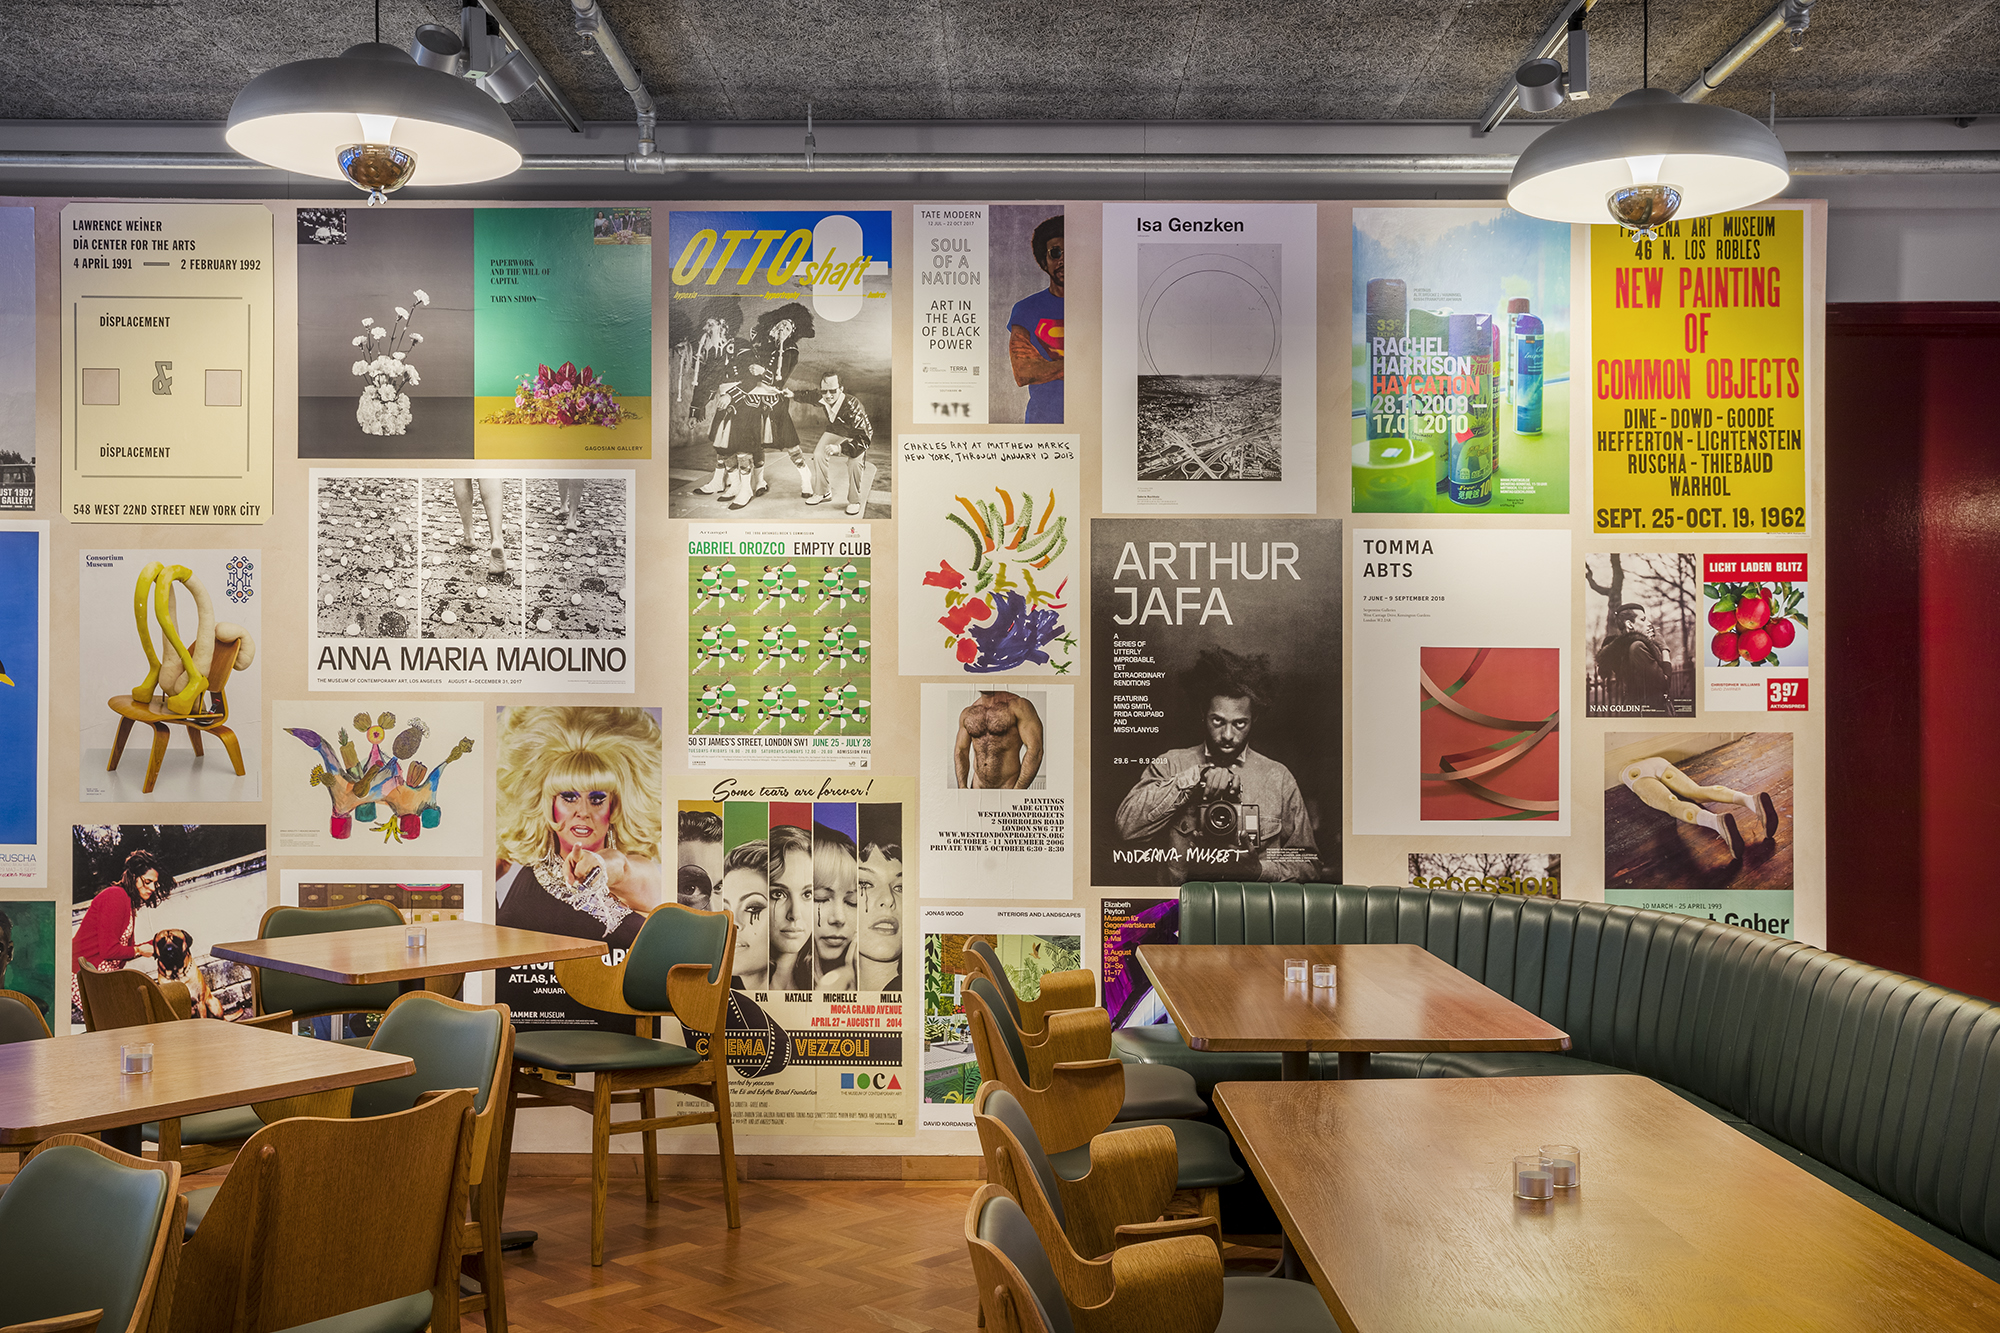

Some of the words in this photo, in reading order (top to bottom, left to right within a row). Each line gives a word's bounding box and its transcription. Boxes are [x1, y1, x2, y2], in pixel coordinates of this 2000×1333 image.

[73, 219, 122, 232] LAWRENCE
[1137, 217, 1162, 232] Isa
[1168, 217, 1244, 232] Genzken
[1691, 216, 1712, 237] ART
[1724, 216, 1775, 237] MUSEUM
[91, 239, 127, 251] CENTER
[130, 239, 148, 251] FOR
[152, 239, 169, 251] THE
[172, 239, 196, 251] ARTS
[931, 238, 971, 252] SOUL
[1685, 240, 1706, 260] LOS
[1716, 240, 1760, 260] ROBLES
[73, 258, 80, 269] 4
[112, 258, 132, 270] 1991
[180, 259, 187, 270] 2
[190, 259, 237, 271] FEBRUARY
[240, 259, 261, 271] 1992
[671, 228, 813, 286] OTTO
[799, 247, 873, 292] shaft
[932, 255, 952, 269] OF
[958, 255, 969, 269] A
[921, 271, 981, 285] NATION
[1615, 267, 1664, 308] NEW
[1679, 267, 1781, 308] PAINTING
[764, 291, 801, 300] hypertrophy
[931, 300, 953, 311] ART
[958, 300, 971, 311] IN
[926, 313, 948, 324] THE
[952, 313, 977, 324] AGE
[922, 326, 937, 337] OF
[942, 326, 981, 337] BLACK
[1685, 312, 1711, 353] OF
[929, 339, 973, 350] POWER
[1372, 337, 1448, 356] RACHEL
[1373, 356, 1471, 375] HARRISON
[1373, 376, 1480, 395] HAYCATION
[1597, 359, 1691, 400] COMMON
[1706, 358, 1799, 399] OBJECTS
[931, 402, 970, 418] TATE
[1372, 395, 1468, 414] 28.11.2009
[1372, 415, 1468, 433] 17.01.2010
[1624, 408, 1656, 429] DINE
[1671, 408, 1713, 428] DOWD
[1727, 407, 1775, 428] GOODE
[903, 442, 947, 451] CHARLES
[950, 441, 968, 450] RAY
[987, 442, 1033, 450] MATTHEW
[1037, 441, 1070, 451] MARKS
[1597, 431, 1683, 452] HEFFERTON
[1697, 430, 1802, 451] LICHTENSTEIN
[1628, 454, 1687, 474] RUSCHA
[1701, 453, 1773, 474] THIEBAUD
[14, 488, 33, 497] 1997
[1669, 476, 1731, 496] WARHOL
[2, 496, 33, 504] GALLERY
[73, 504, 91, 516] 548
[94, 504, 120, 516] WEST
[123, 504, 147, 516] 22ND
[151, 504, 186, 516] STREET
[189, 504, 209, 517] NEW
[213, 504, 237, 517] YORK
[1597, 508, 1646, 529] SEPT.
[1733, 507, 1755, 527] 19,
[1761, 506, 1806, 528] 1962
[689, 541, 736, 555] GABRIEL
[739, 541, 785, 555] OROZCO
[794, 542, 835, 555] EMPTY
[839, 542, 871, 556] CLUB
[1363, 540, 1434, 555] TOMMA
[1113, 542, 1301, 580] ARTHUR
[1709, 562, 1737, 572] LICHT
[1741, 562, 1772, 572] LADEN
[1776, 562, 1802, 572] BLITZ
[1363, 563, 1413, 577] ABTS
[1113, 587, 1233, 625] JAFA
[317, 646, 391, 671] ANNA
[400, 646, 488, 671] MARIA
[497, 647, 626, 672] MAIOLINO
[1770, 682, 1799, 703] 3.97
[737, 738, 763, 747] STREET,
[764, 738, 792, 747] LONDON
[794, 738, 808, 747] SW1
[812, 738, 828, 746] JUNE
[846, 739, 862, 747] JULY
[712, 778, 755, 804] Some
[760, 786, 790, 797] tears
[816, 777, 873, 800] forever!
[0, 853, 37, 863] RUSCHA
[1113, 848, 1182, 863] MODERNA
[1186, 848, 1249, 863] MUSEET
[1412, 870, 1559, 896] secession
[1725, 913, 1790, 934] Gober
[509, 974, 548, 984] ATLAS,
[755, 993, 768, 1002] EVA
[785, 993, 813, 1002] NATALIE
[823, 993, 857, 1003] MICHELLE
[880, 994, 902, 1003] MILLA
[851, 1005, 876, 1015] GRAND
[876, 1005, 902, 1015] AVENUE
[795, 1039, 870, 1057] VEZZOLI
